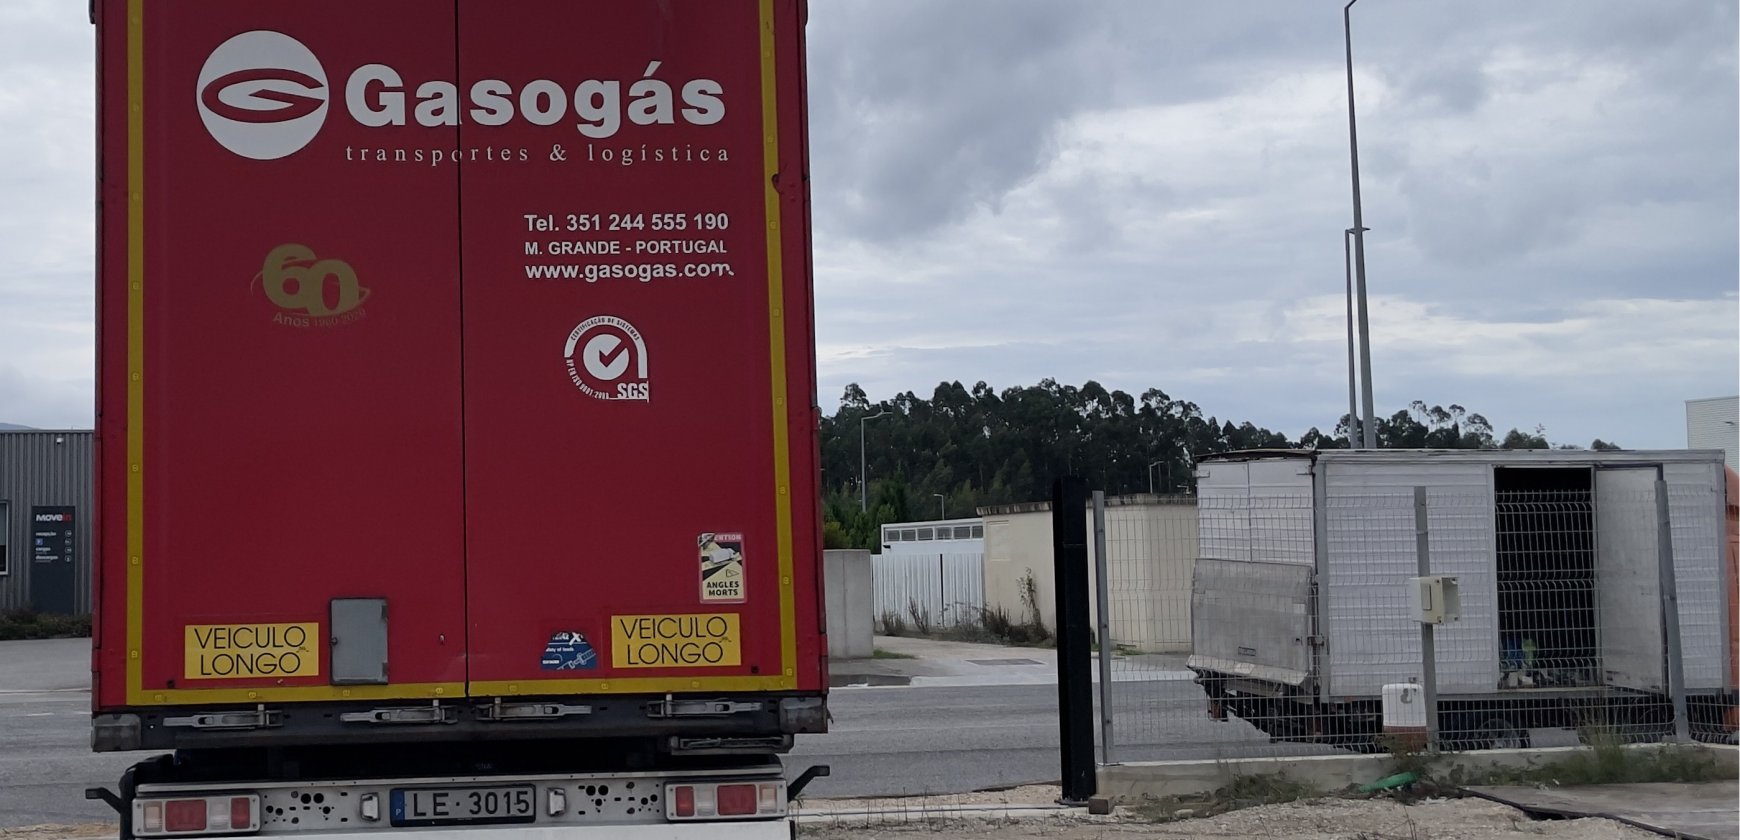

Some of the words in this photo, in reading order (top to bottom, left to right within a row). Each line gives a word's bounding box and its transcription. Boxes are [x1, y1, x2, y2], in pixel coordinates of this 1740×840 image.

[346, 61, 725, 138] Gasogás
[346, 145, 528, 166] transportes
[549, 144, 567, 161] &
[588, 144, 729, 165] logística
[524, 214, 559, 231] Tel.
[566, 214, 600, 230] 351
[608, 214, 645, 230] 244
[651, 213, 687, 230] 555
[694, 213, 729, 230] 190
[524, 242, 543, 255] M.
[548, 241, 620, 254] GRANDE
[636, 240, 728, 254] PORTUGAL
[262, 243, 360, 316] 60
[272, 312, 310, 327] Anos
[617, 383, 648, 398] SGS
[707, 581, 740, 589] ANGLES
[194, 626, 306, 649] VEICULO
[620, 616, 728, 639] VEICULO
[201, 652, 301, 675] LONGO
[627, 641, 724, 665] LONGO
